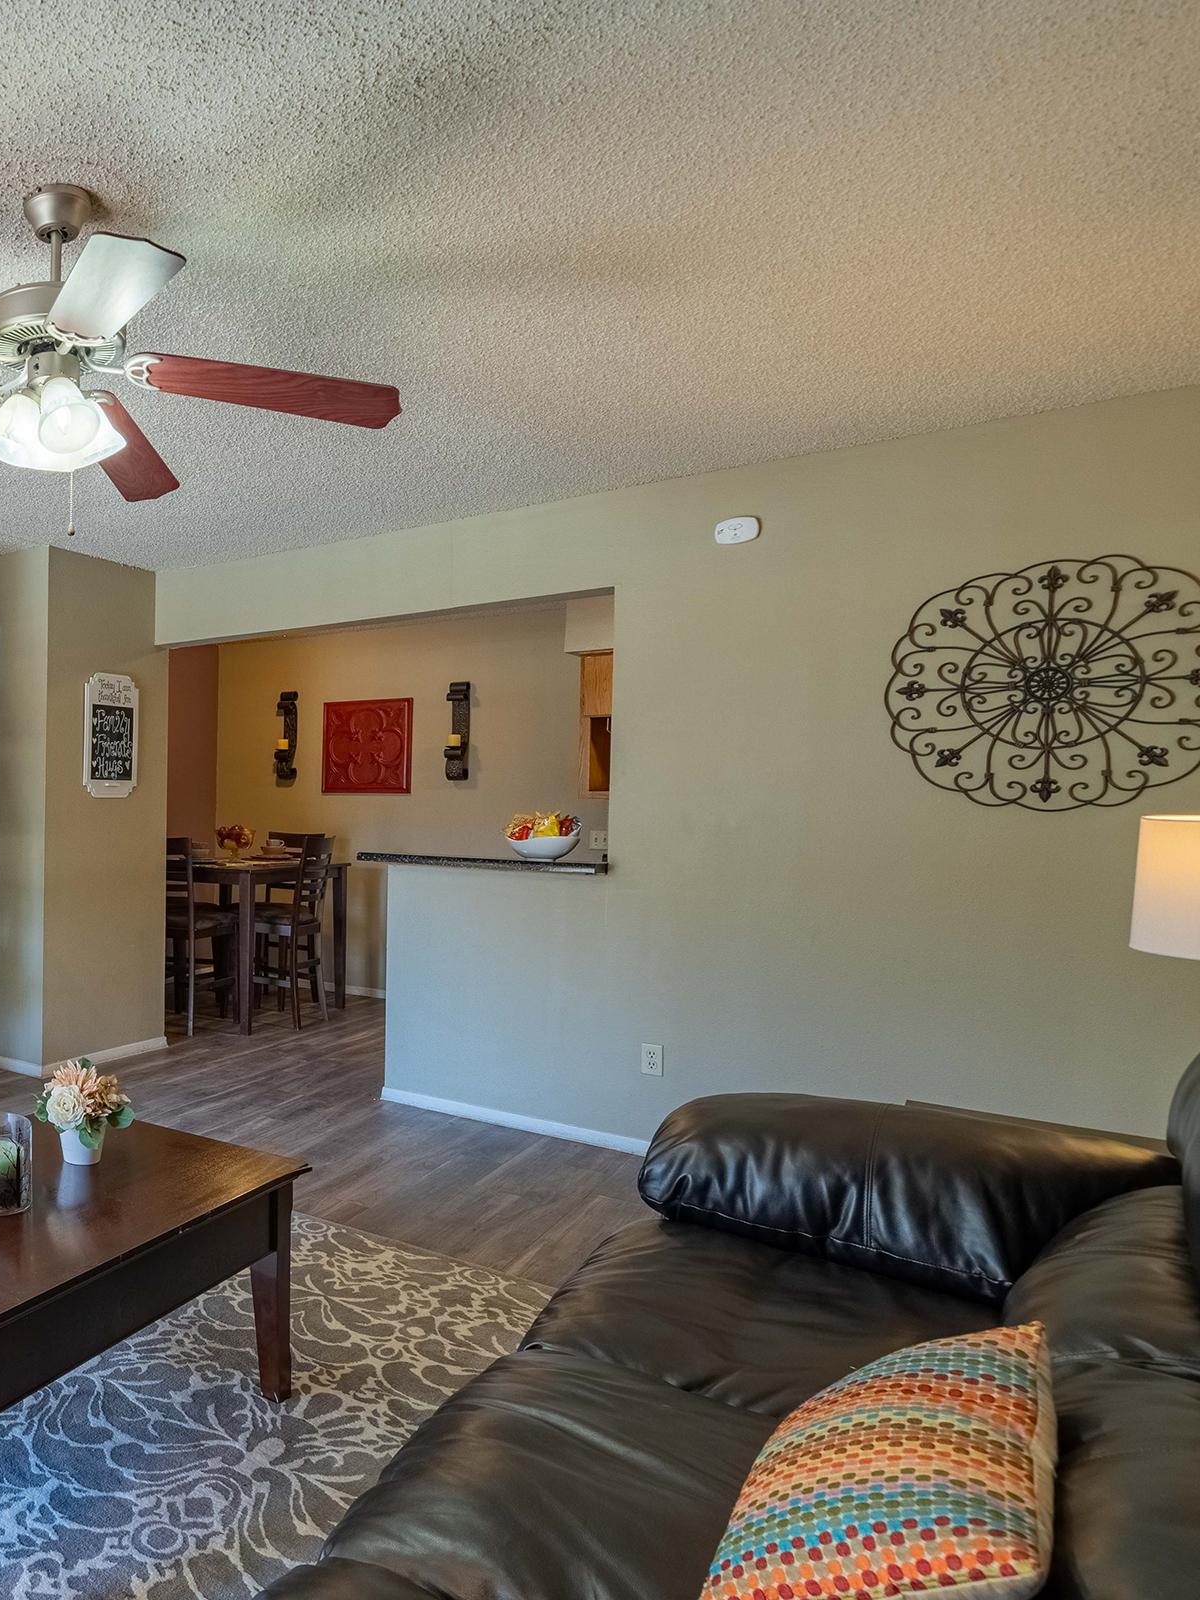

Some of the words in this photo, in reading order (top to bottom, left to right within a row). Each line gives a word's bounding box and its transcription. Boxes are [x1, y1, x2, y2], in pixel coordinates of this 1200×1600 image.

[116, 680, 122, 693] I
[96, 709, 131, 742] Family
[95, 733, 132, 759] Friends
[95, 757, 124, 780] Hugs
